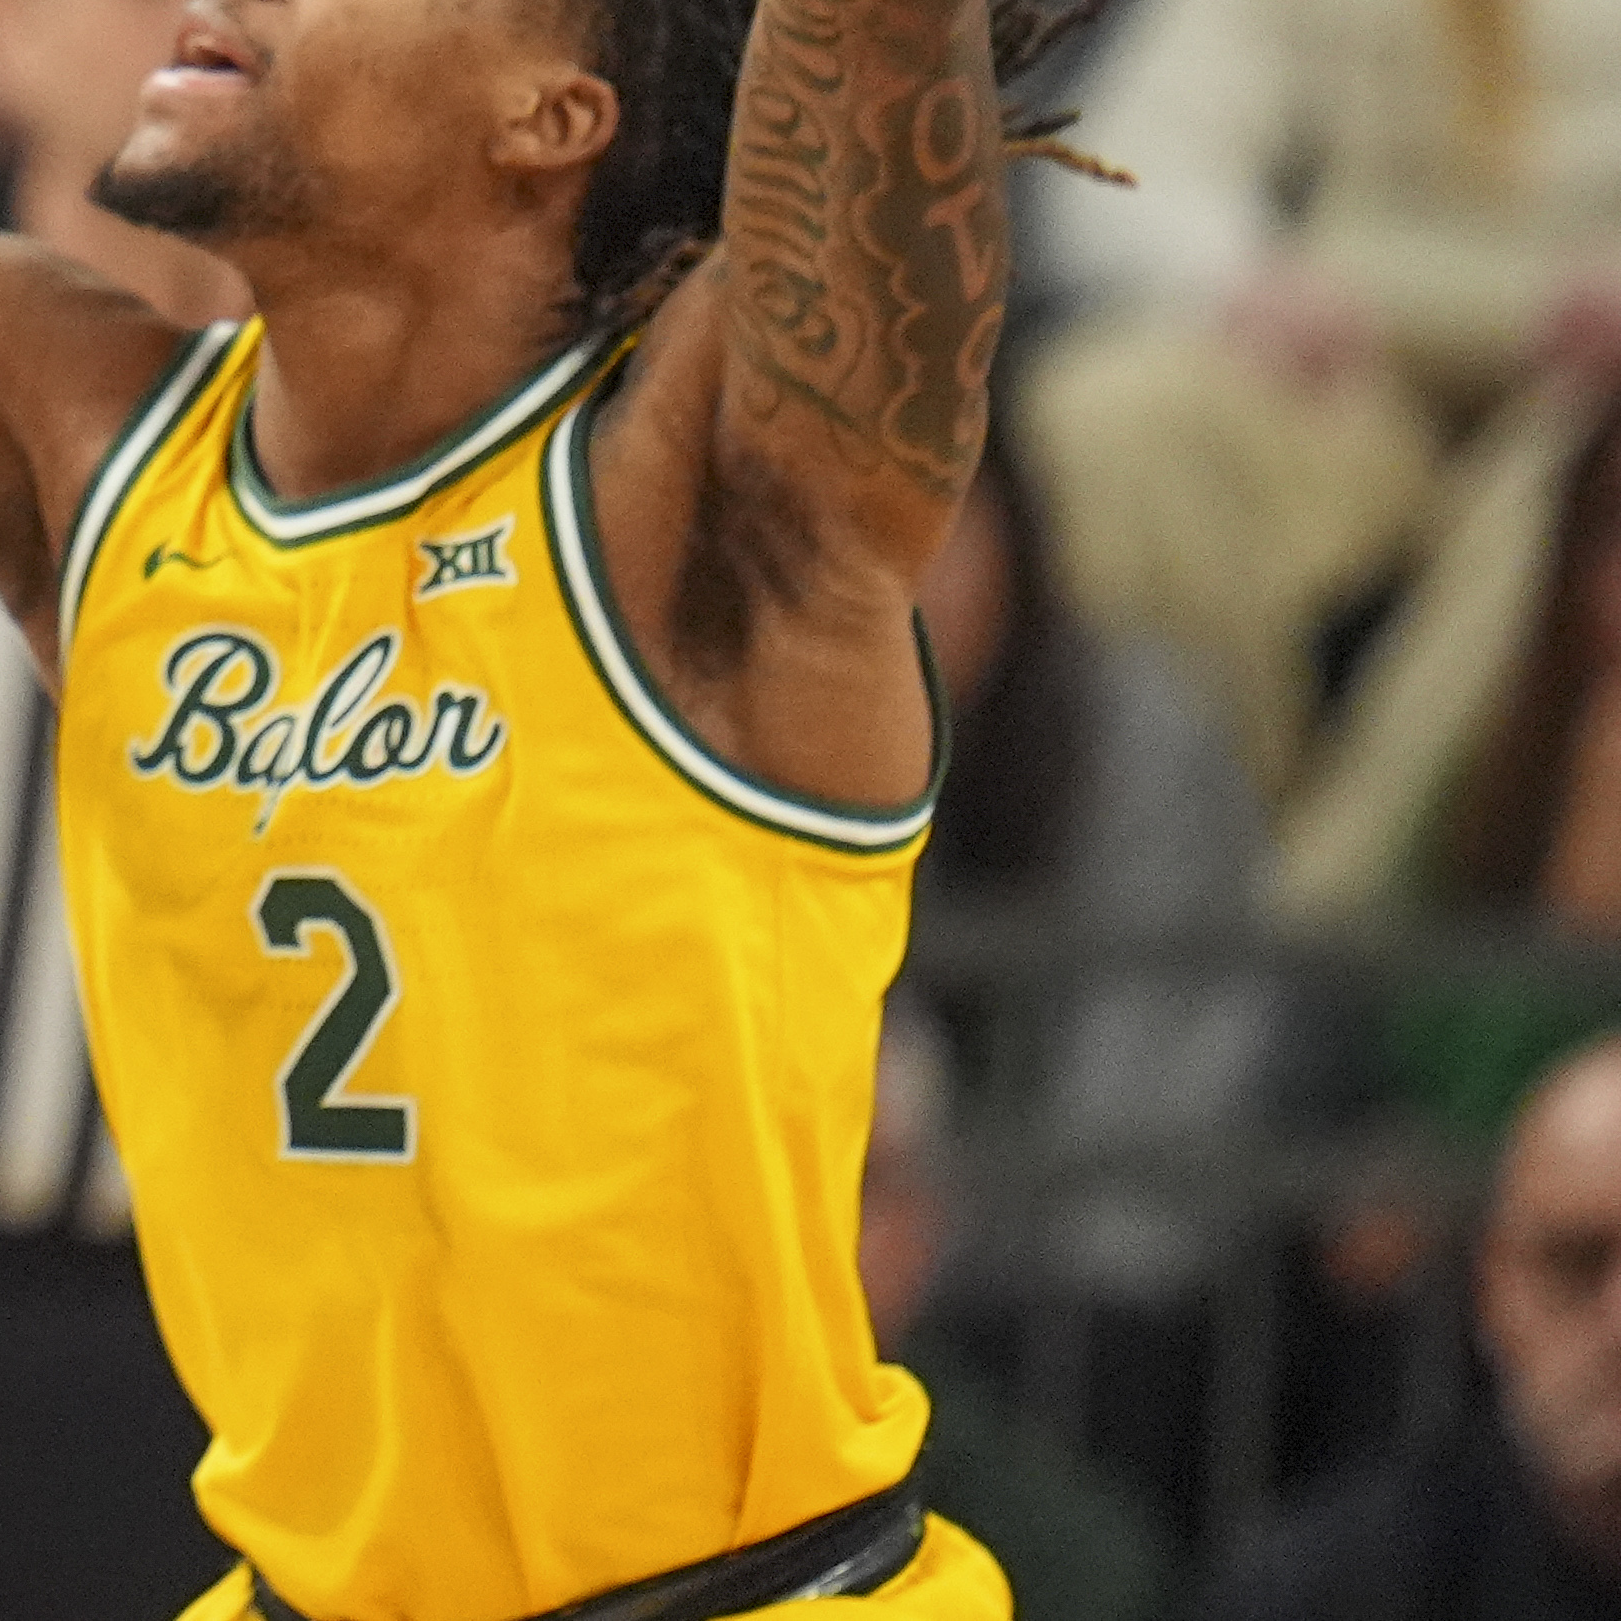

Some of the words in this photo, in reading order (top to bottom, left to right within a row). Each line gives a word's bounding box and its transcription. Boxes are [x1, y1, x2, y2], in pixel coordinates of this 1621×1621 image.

[417, 518, 514, 597] XII
[129, 625, 508, 837] Balor
[252, 868, 417, 1165] 2
